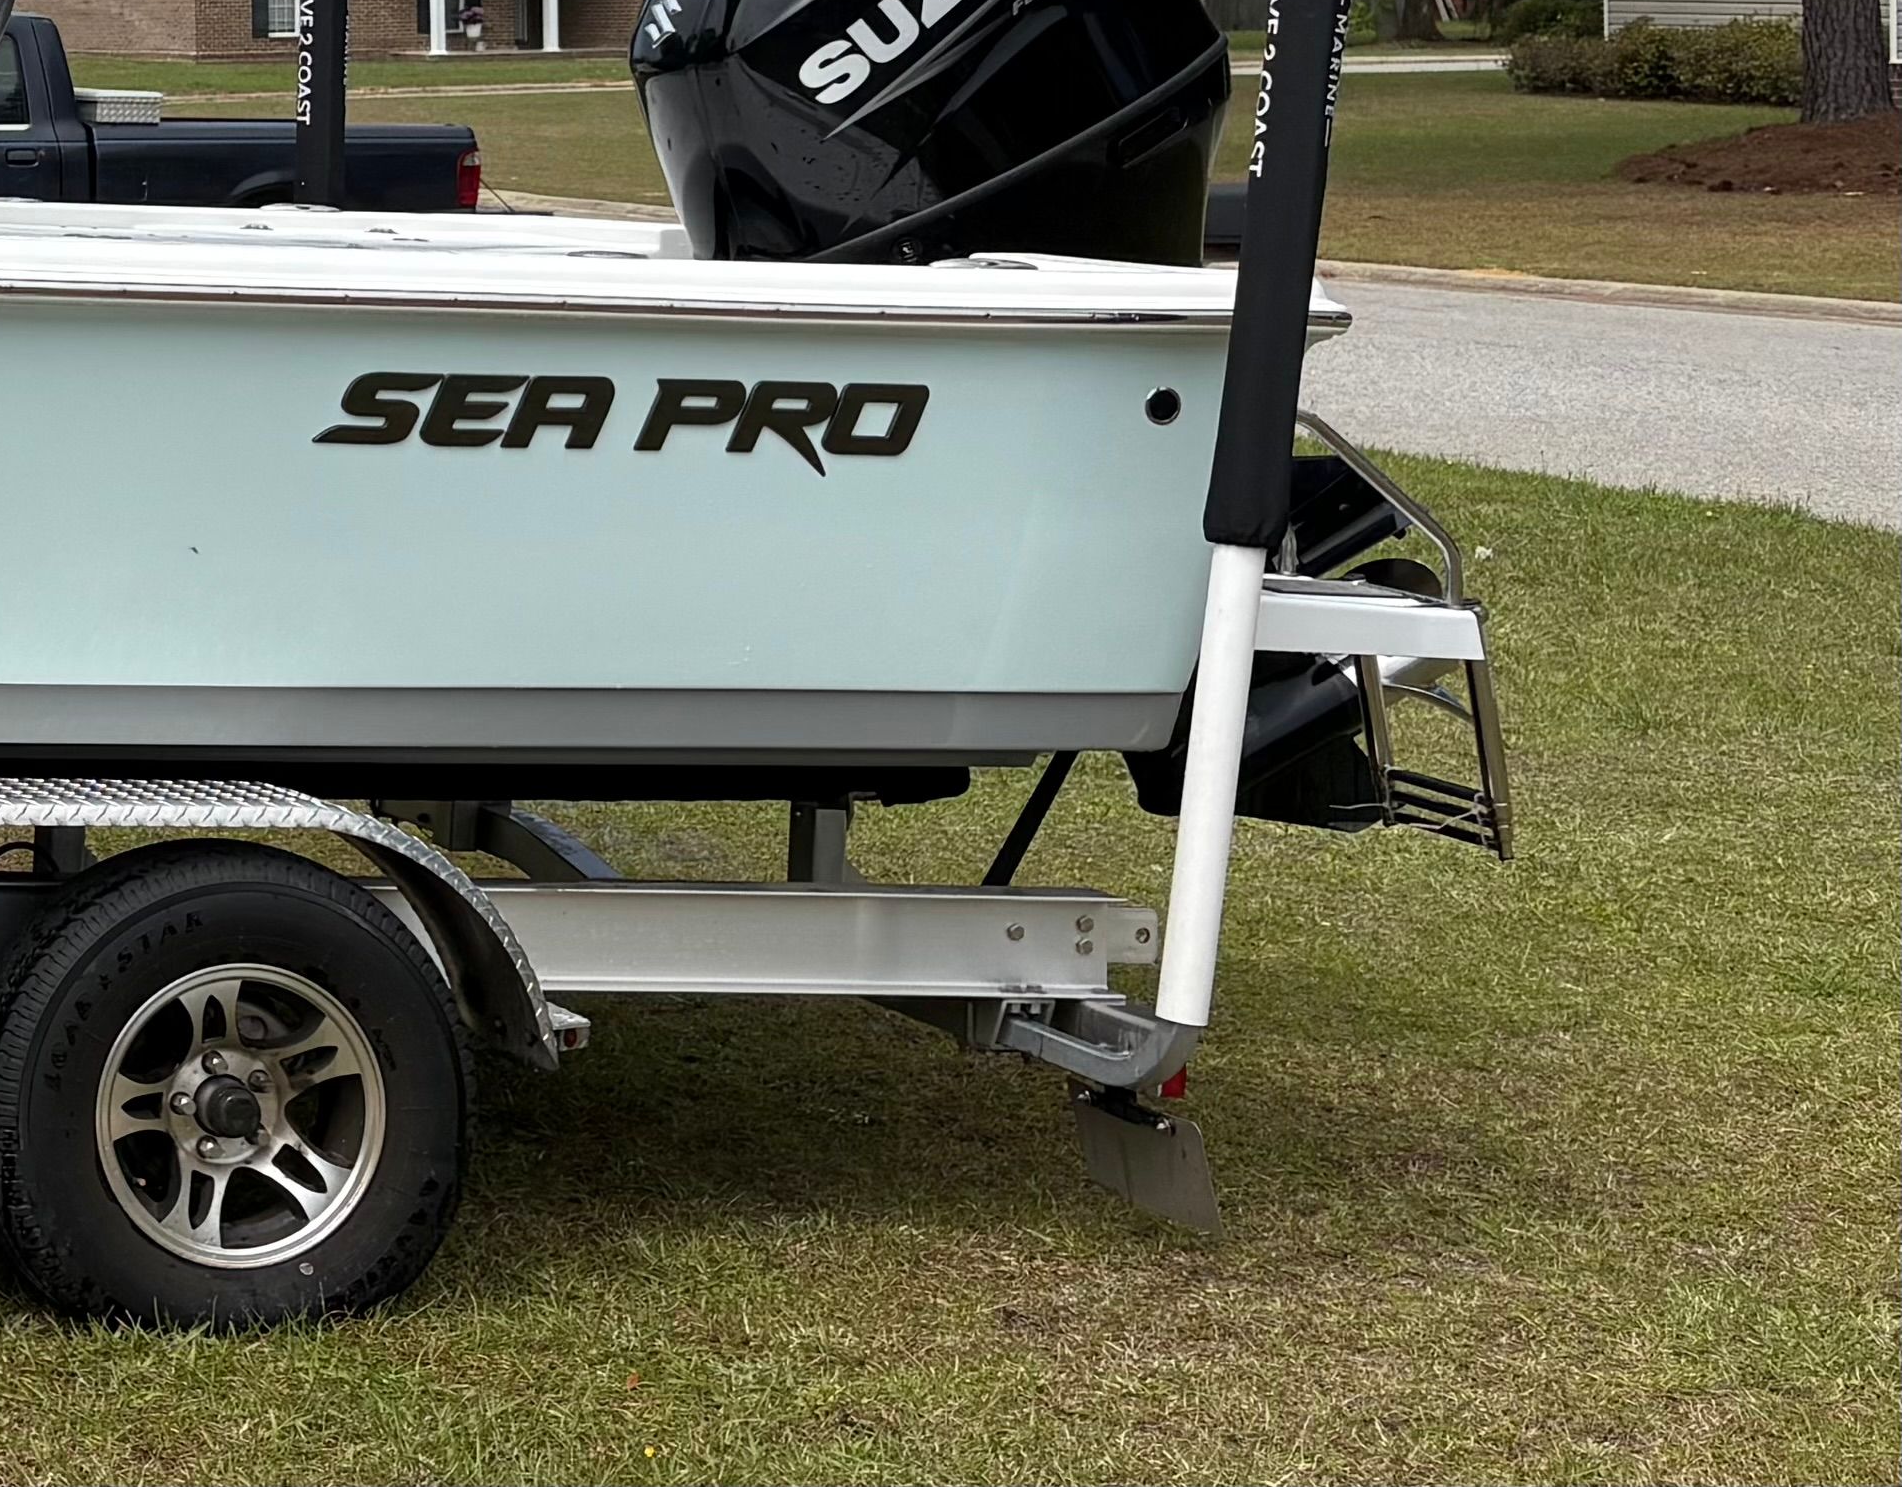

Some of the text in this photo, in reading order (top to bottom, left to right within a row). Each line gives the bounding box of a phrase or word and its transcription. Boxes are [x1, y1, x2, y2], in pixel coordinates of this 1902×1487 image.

[296, 51, 312, 125] COAST
[299, 33, 313, 46] 2
[1325, 14, 1348, 116] MARINE
[1249, 70, 1273, 178] COAST
[312, 372, 930, 477] SEA PRO
